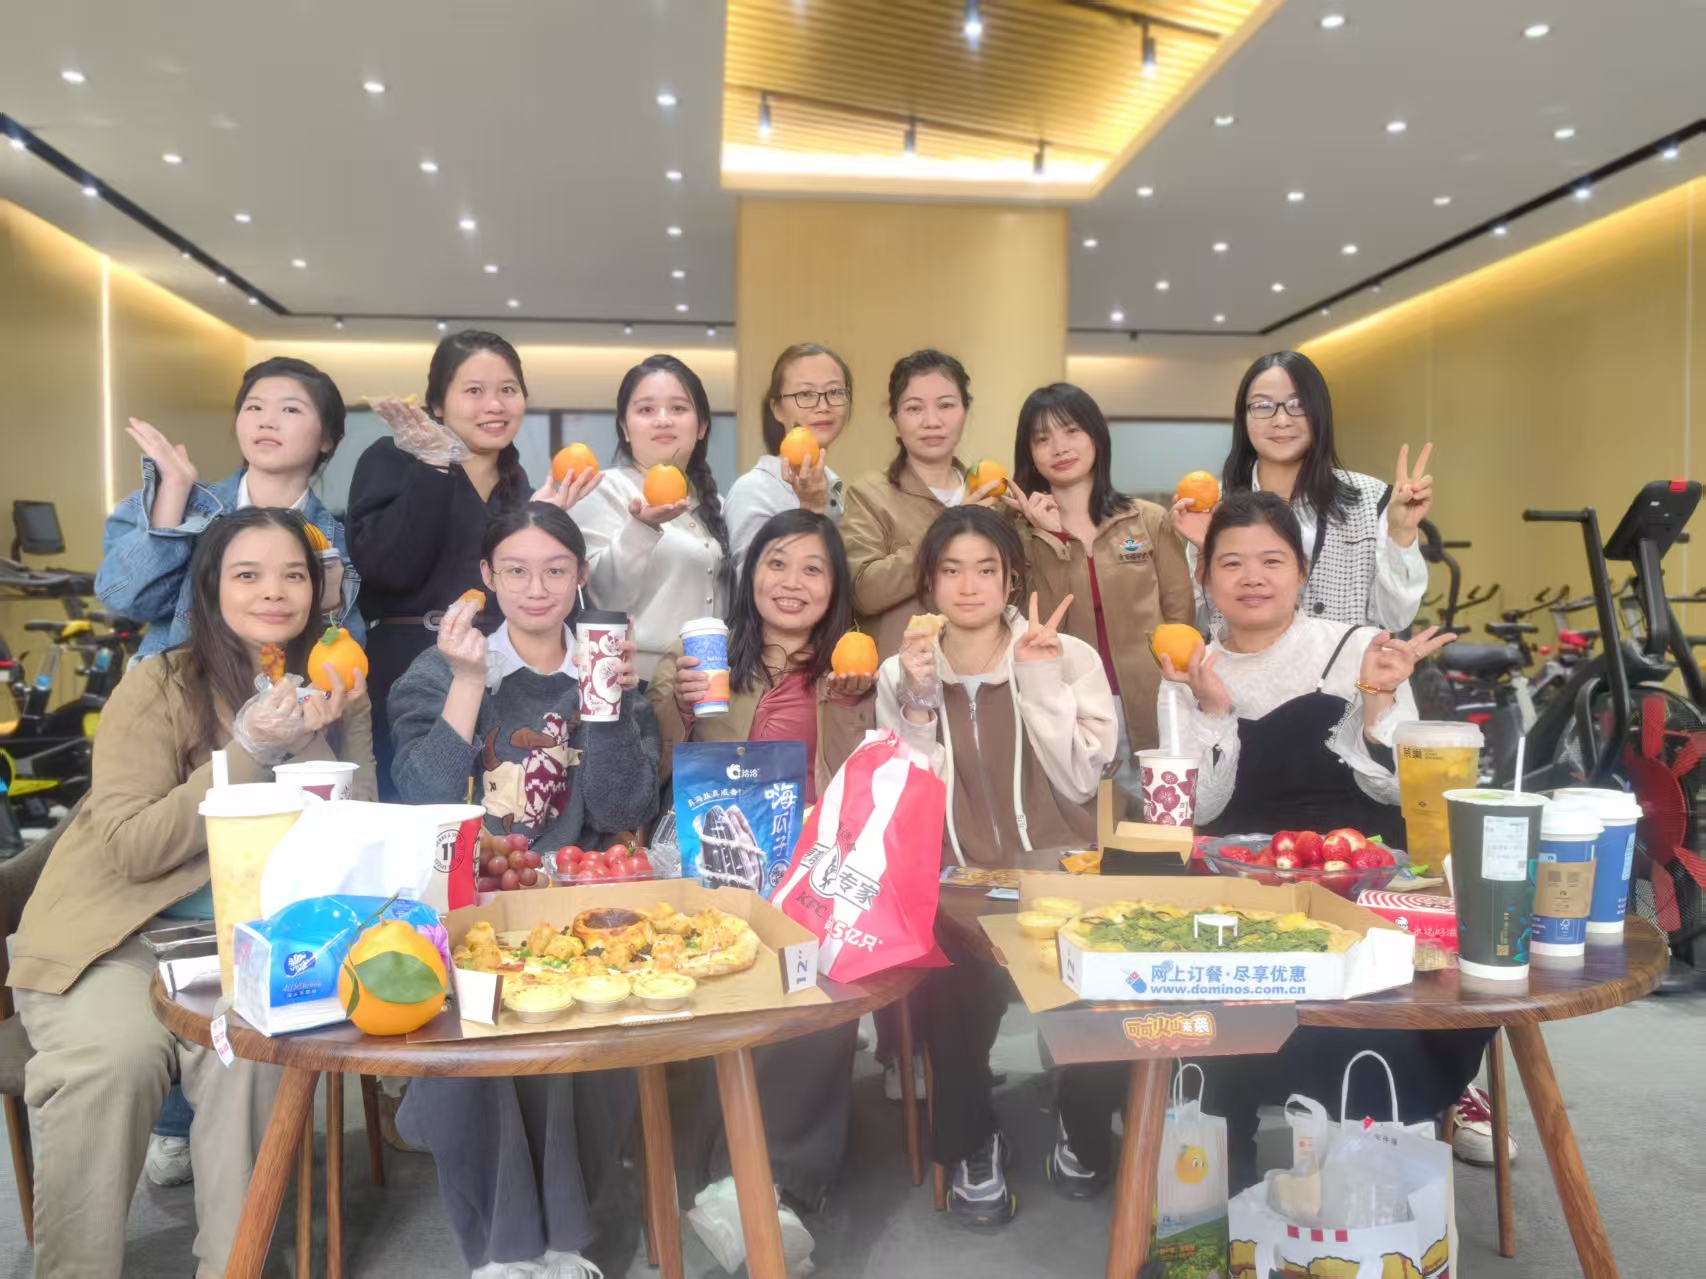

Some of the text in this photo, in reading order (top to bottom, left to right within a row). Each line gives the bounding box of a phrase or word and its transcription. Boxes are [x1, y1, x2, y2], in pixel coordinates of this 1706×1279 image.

[839, 870, 881, 905] 专家
[794, 891, 828, 918] KFC
[1151, 965, 1308, 983] 网上订餐·尽享优惠
[1150, 983, 1307, 995] www.dominos.com.cn
